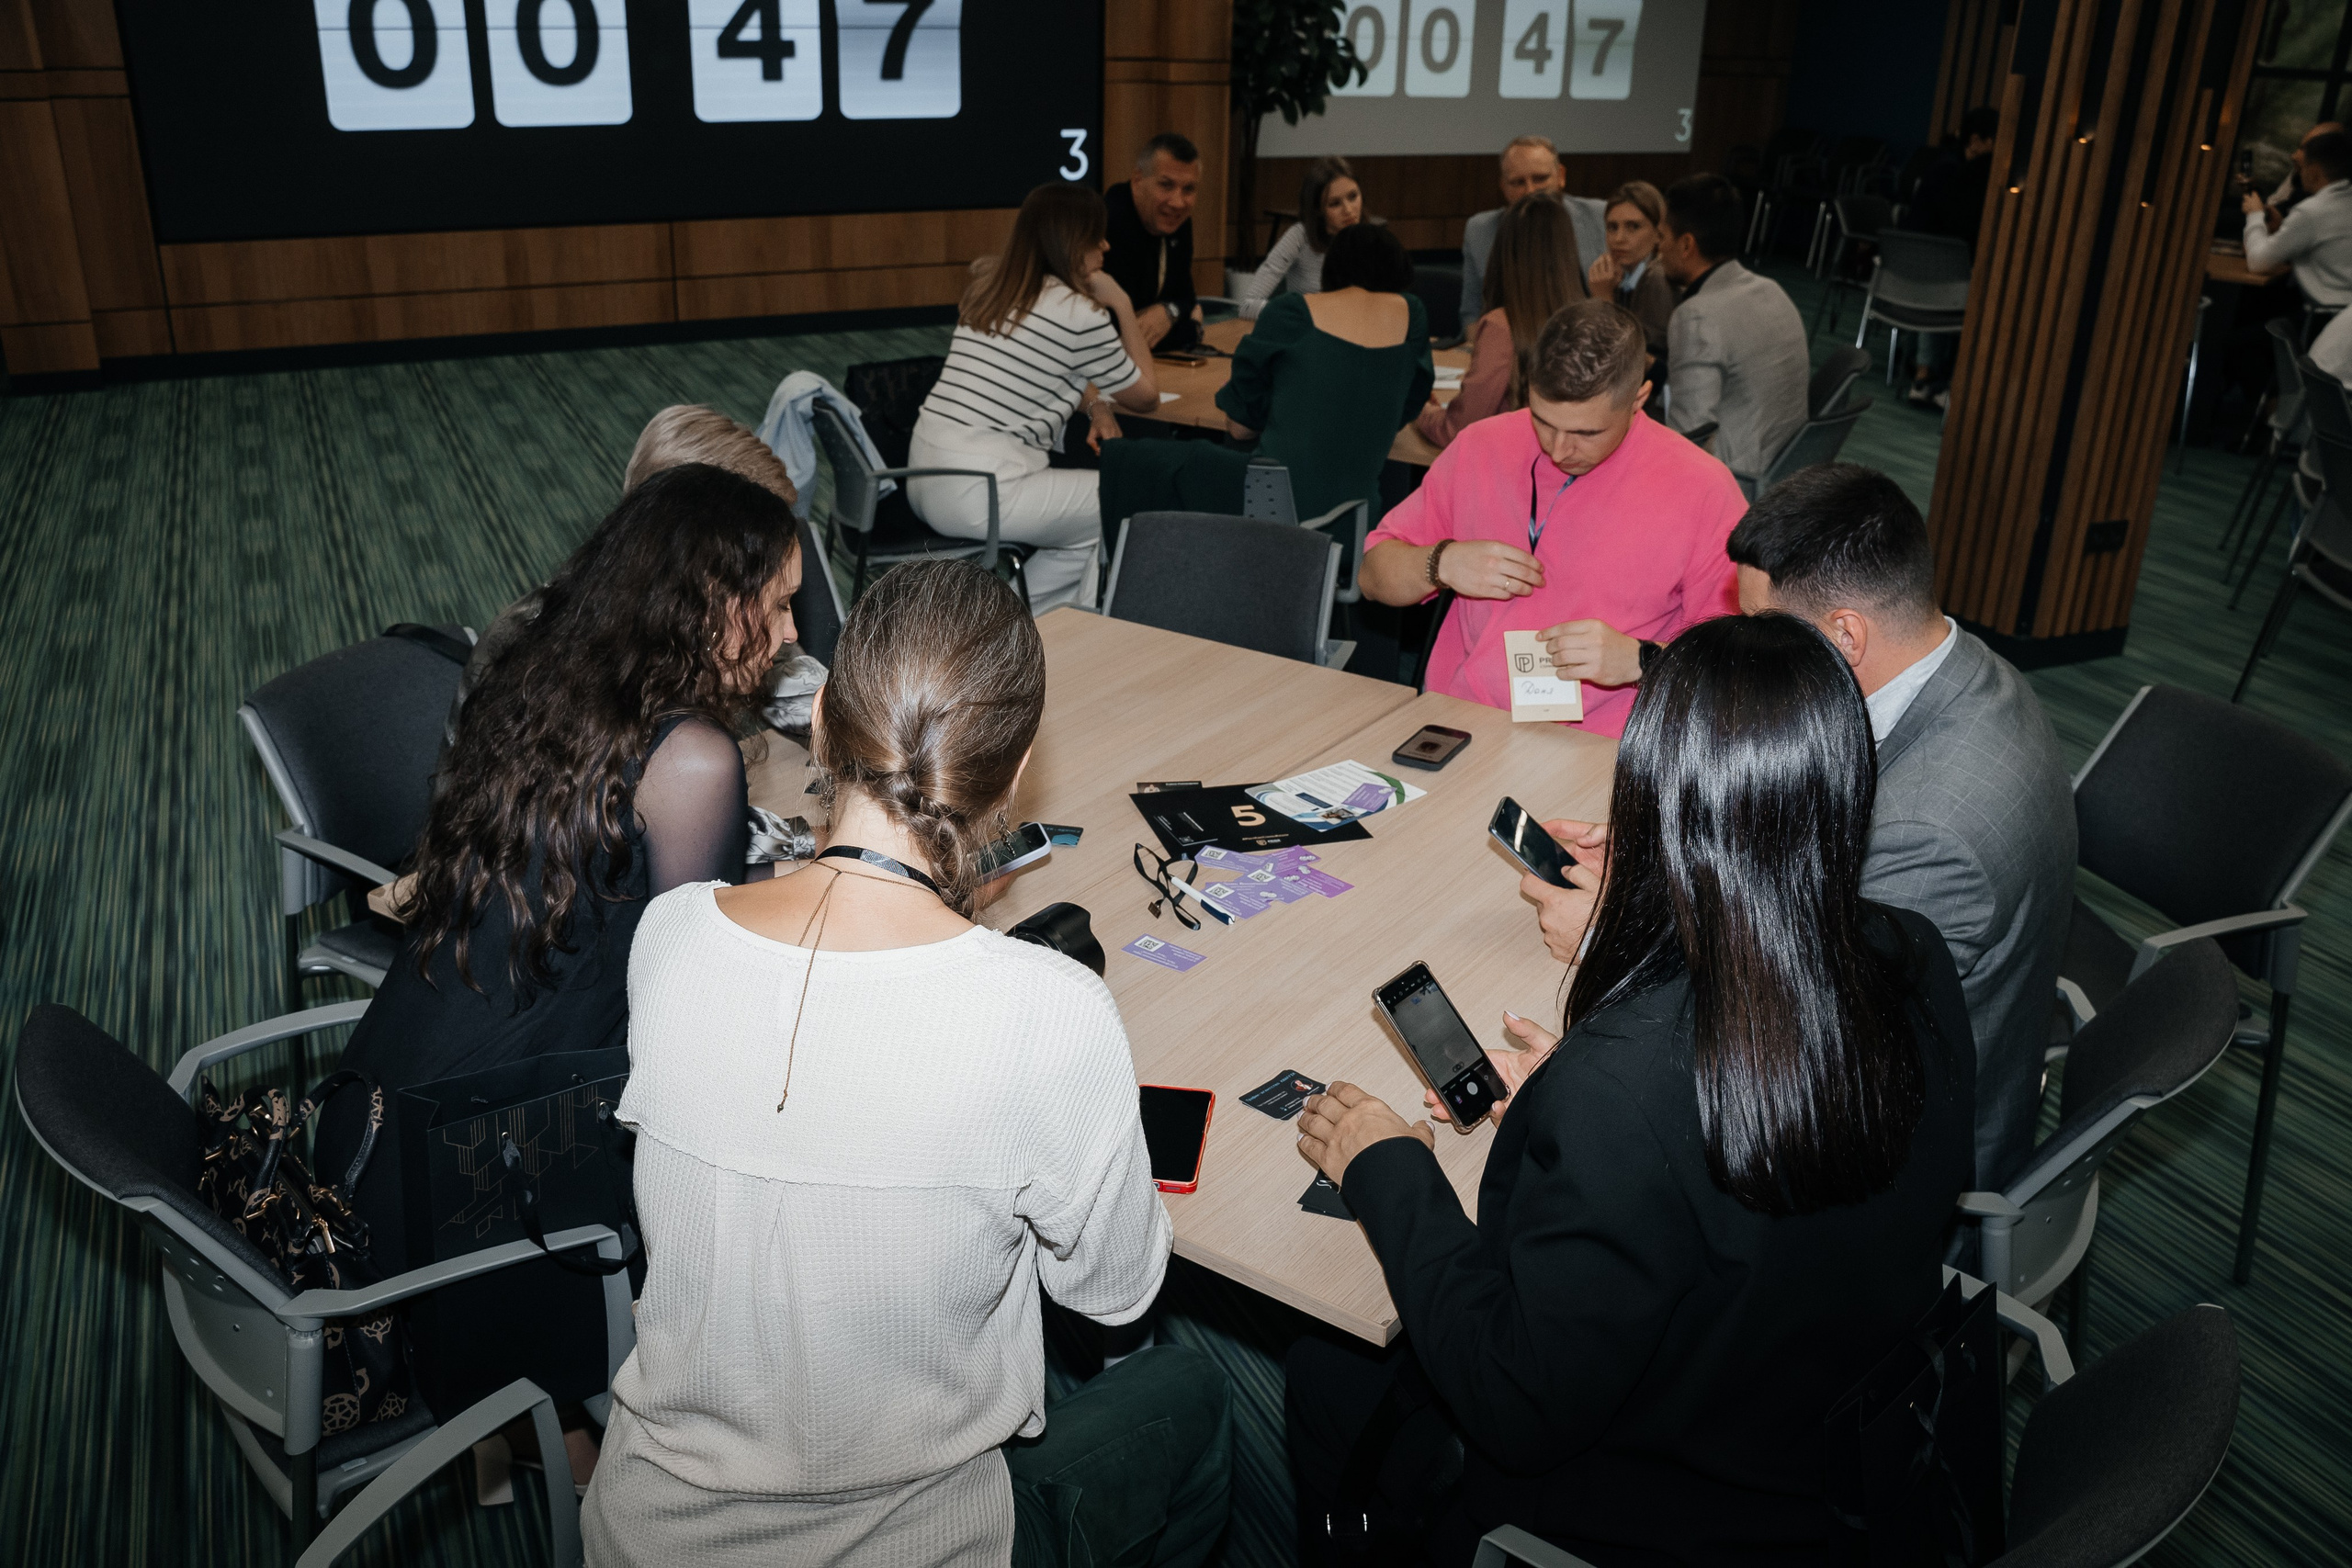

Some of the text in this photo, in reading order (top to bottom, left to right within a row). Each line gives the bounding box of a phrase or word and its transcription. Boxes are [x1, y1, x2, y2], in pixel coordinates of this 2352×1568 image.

[1674, 108, 1692, 141] 3
[1059, 129, 1089, 181] 3
[1230, 805, 1266, 827] 5
